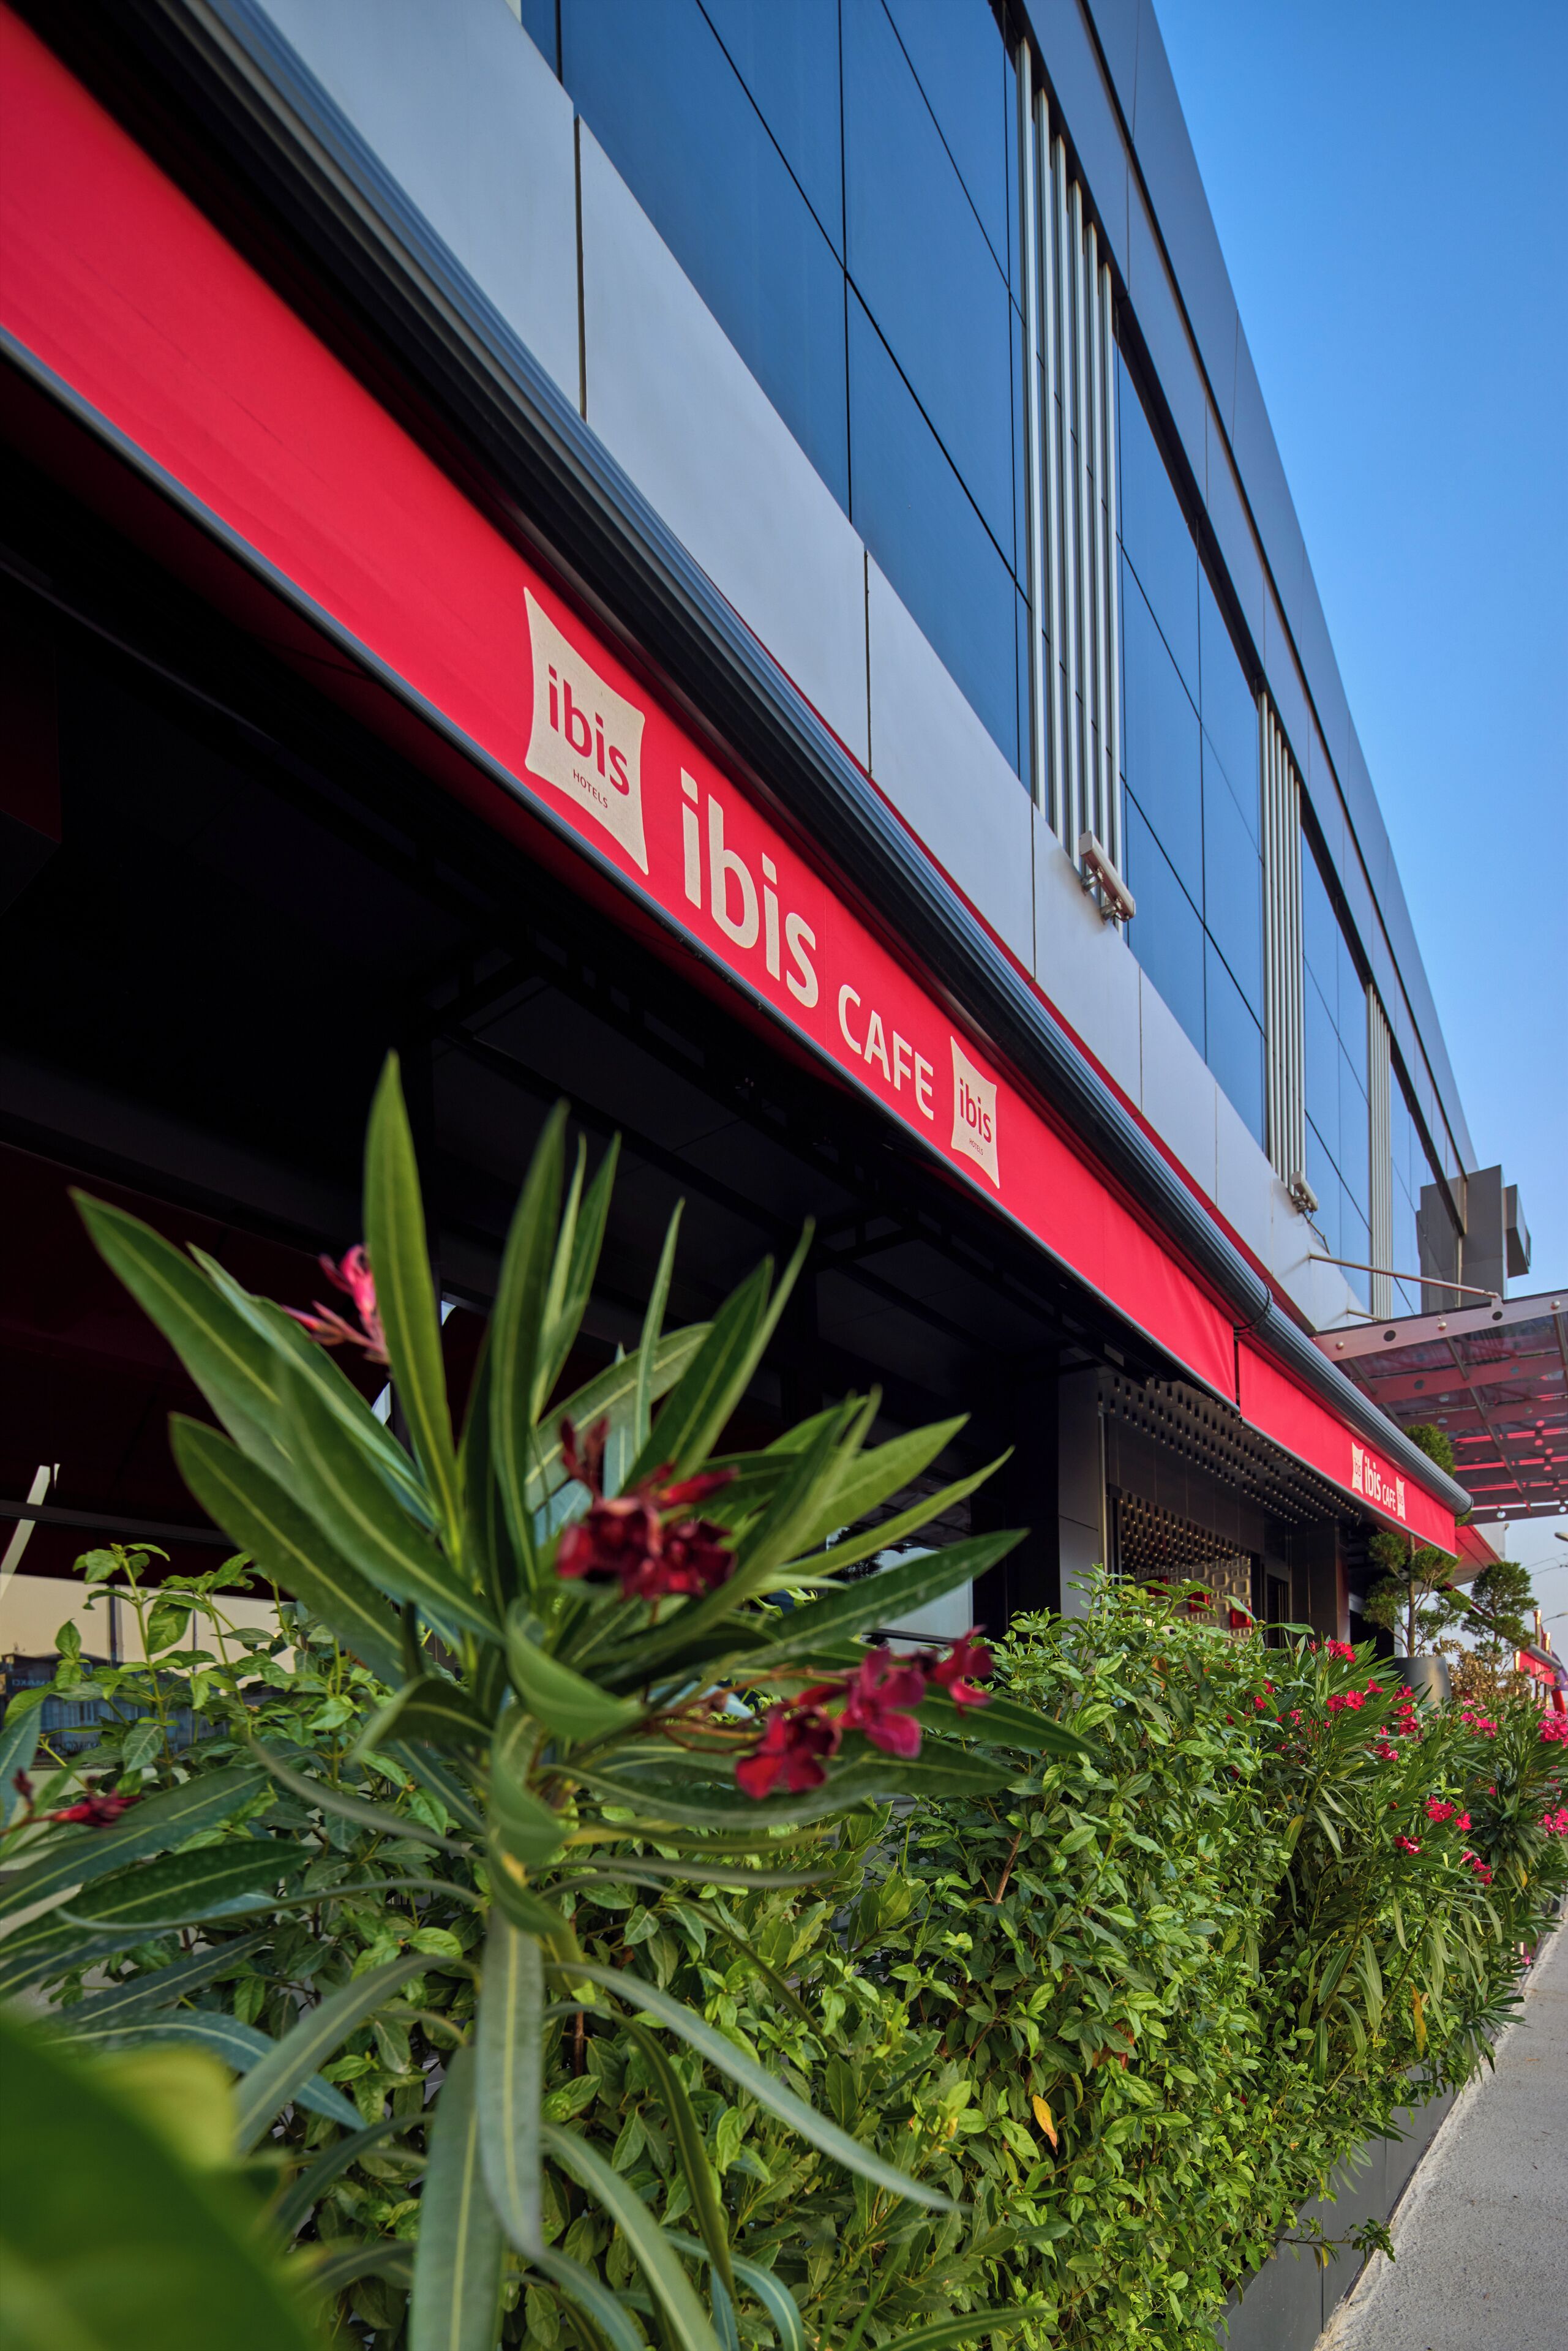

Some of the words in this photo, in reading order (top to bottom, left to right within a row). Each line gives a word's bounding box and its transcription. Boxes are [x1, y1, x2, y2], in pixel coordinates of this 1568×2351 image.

[548, 664, 630, 796] ibis
[572, 769, 609, 809] HOTELS
[681, 767, 819, 1008] ibis
[838, 984, 934, 1121] CAFE
[959, 1077, 992, 1144] ibis
[969, 1138, 984, 1156] HOTELS
[1365, 1456, 1381, 1501] ibis
[1382, 1484, 1396, 1512] CAFE
